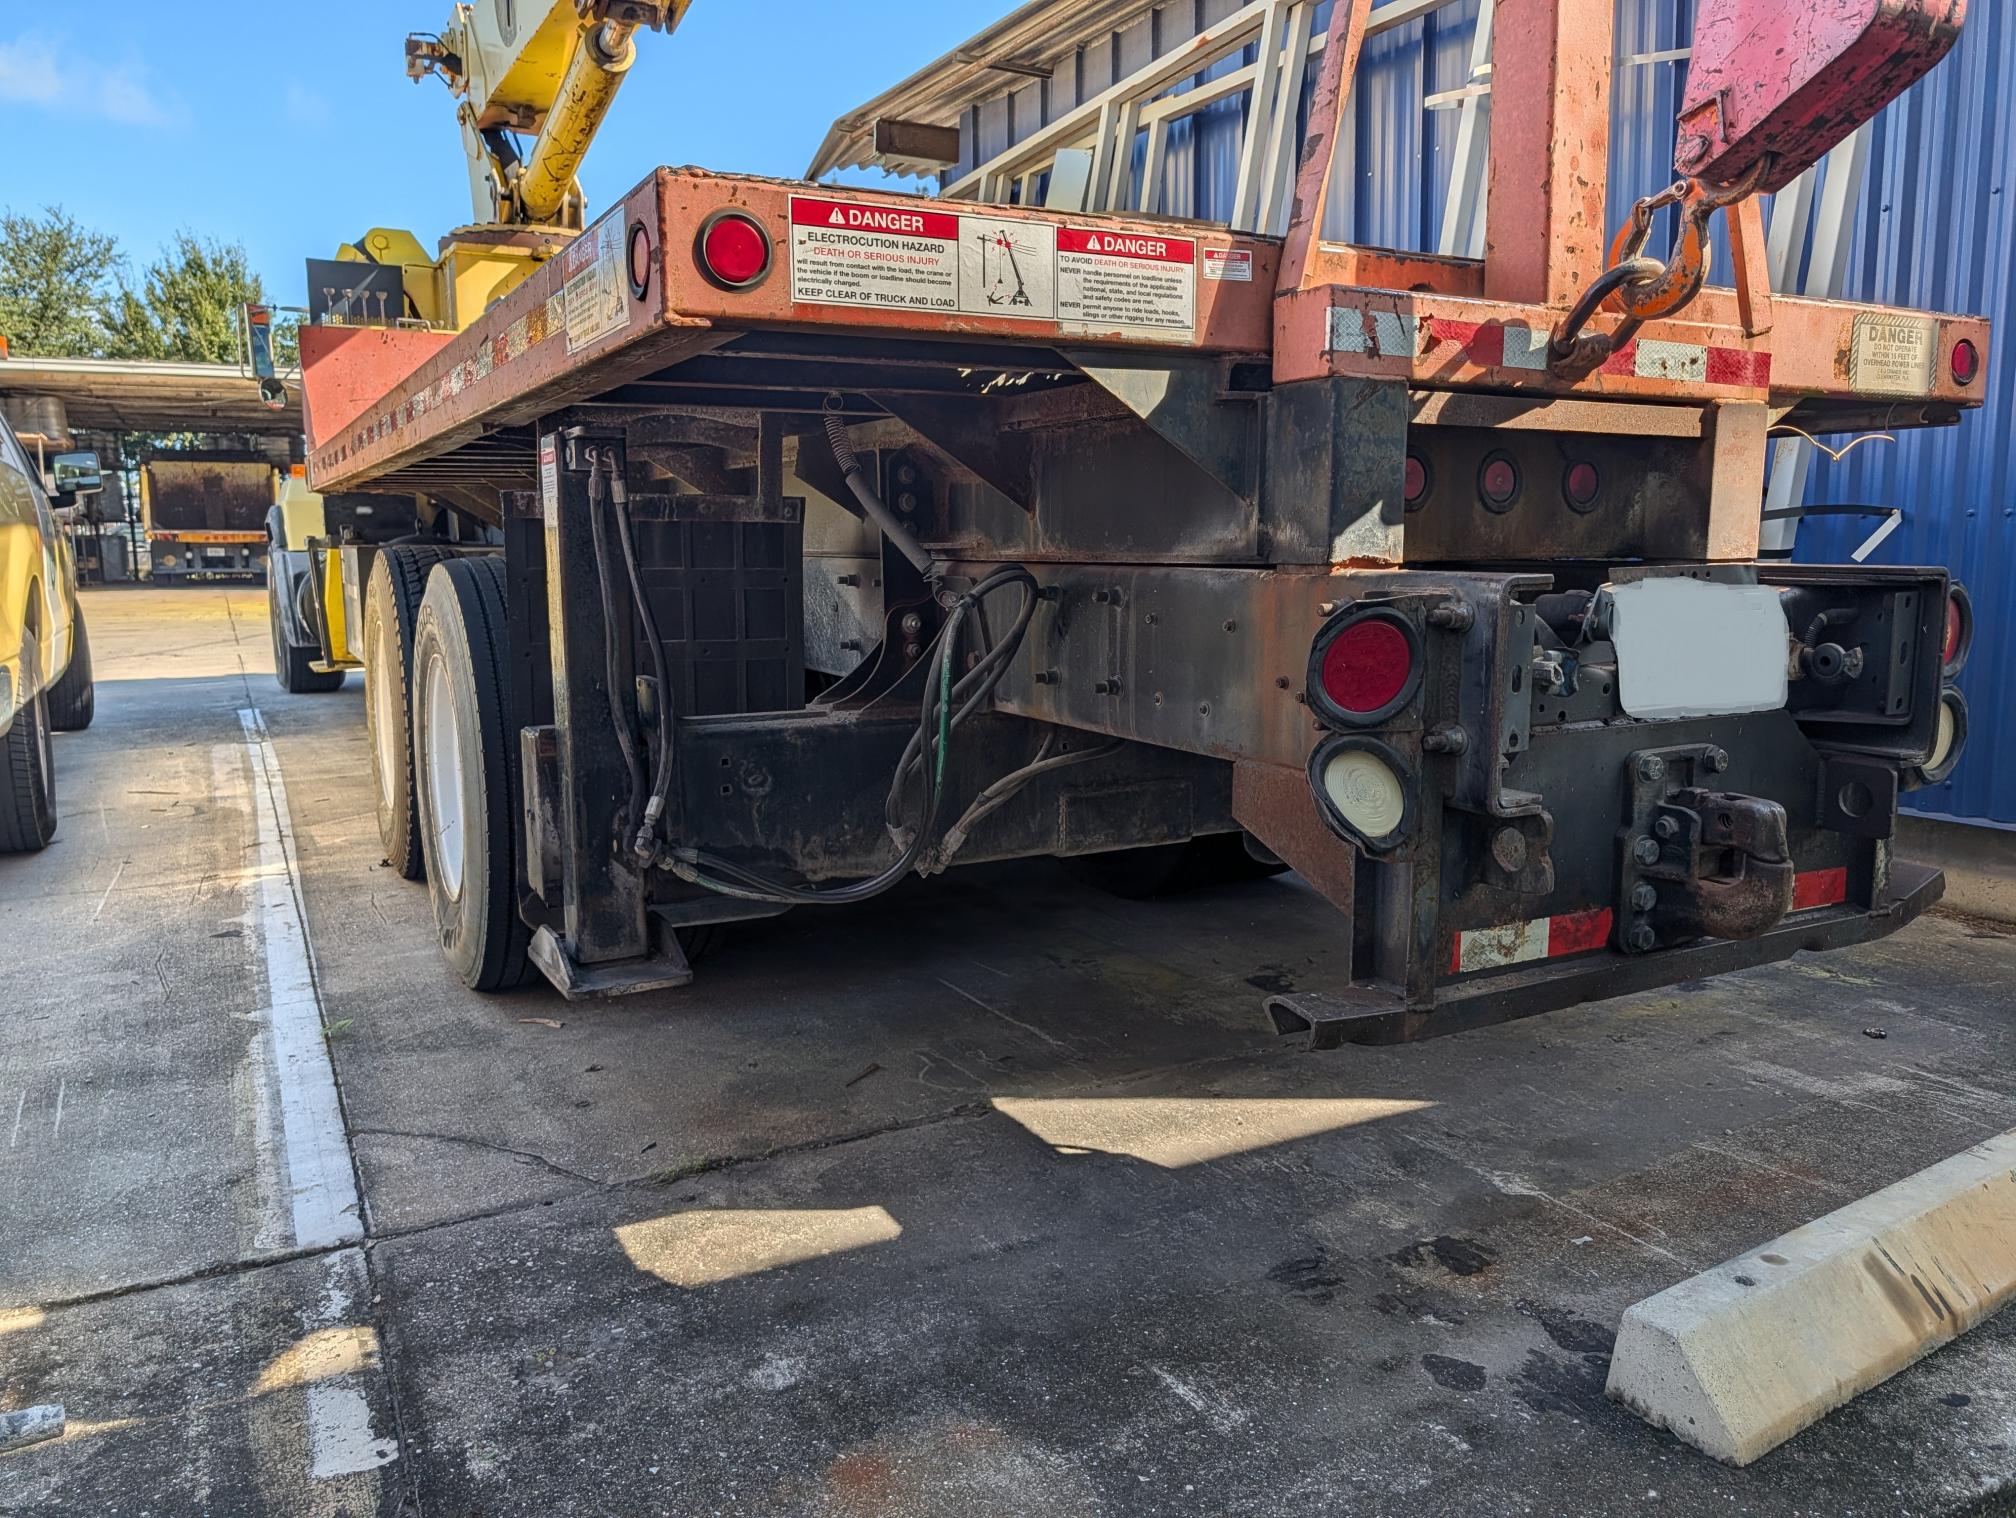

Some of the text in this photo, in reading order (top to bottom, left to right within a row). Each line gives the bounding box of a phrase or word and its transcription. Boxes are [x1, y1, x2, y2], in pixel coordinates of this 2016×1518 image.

[849, 210, 923, 232] DANGER
[808, 232, 944, 253] ELECTROCUTION HAZARD
[1104, 237, 1166, 256] DANGER
[814, 247, 939, 265] DEATH OR SERIOUS INJURY
[1095, 259, 1116, 267] DEATH
[1130, 262, 1159, 271] SERIOUS
[798, 277, 832, 285] electrically
[1094, 279, 1130, 287] requirements
[1143, 274, 1162, 282] loadline
[1083, 286, 1107, 294] national,
[798, 288, 955, 307] KEEP CLEAR OF TRUCK AND LOAD
[1869, 326, 1922, 345] DANGER
[1895, 345, 1917, 353] OPERATE
[1864, 359, 1890, 367] OVERHEAD
[1892, 360, 1909, 368] POWER
